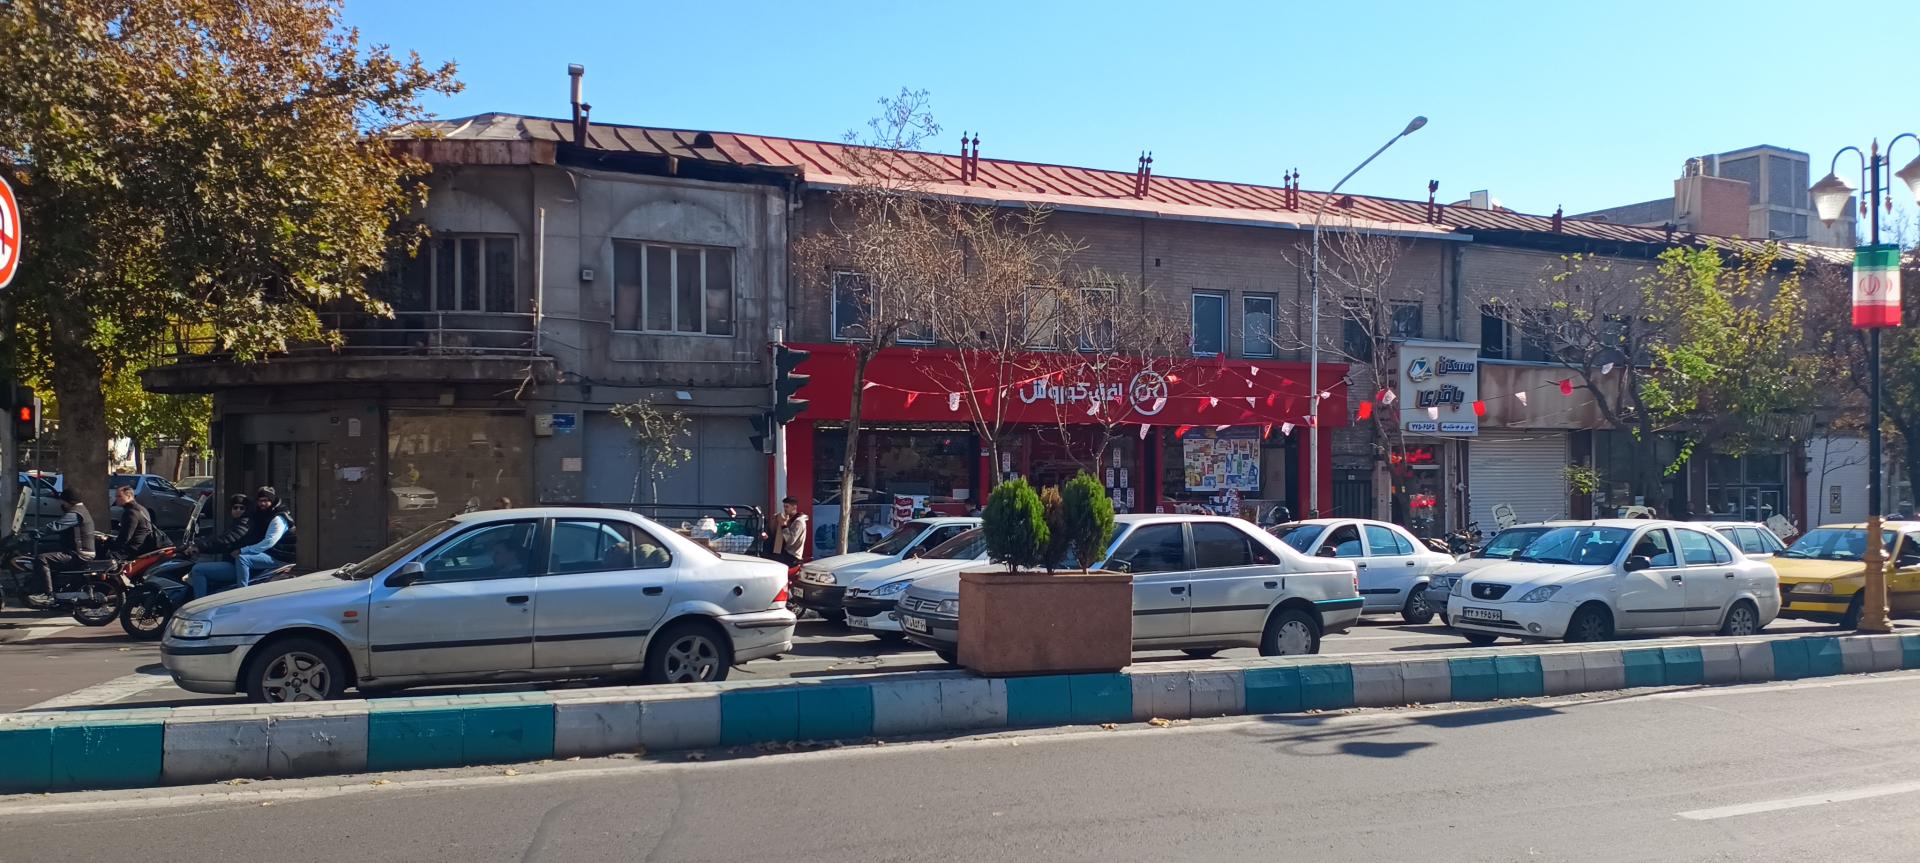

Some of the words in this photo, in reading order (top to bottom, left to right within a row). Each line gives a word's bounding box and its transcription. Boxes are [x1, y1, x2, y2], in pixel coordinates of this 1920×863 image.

[1437, 356, 1475, 375] مسکن
[1019, 379, 1090, 404] کوروش
[1418, 384, 1465, 410] باقری
